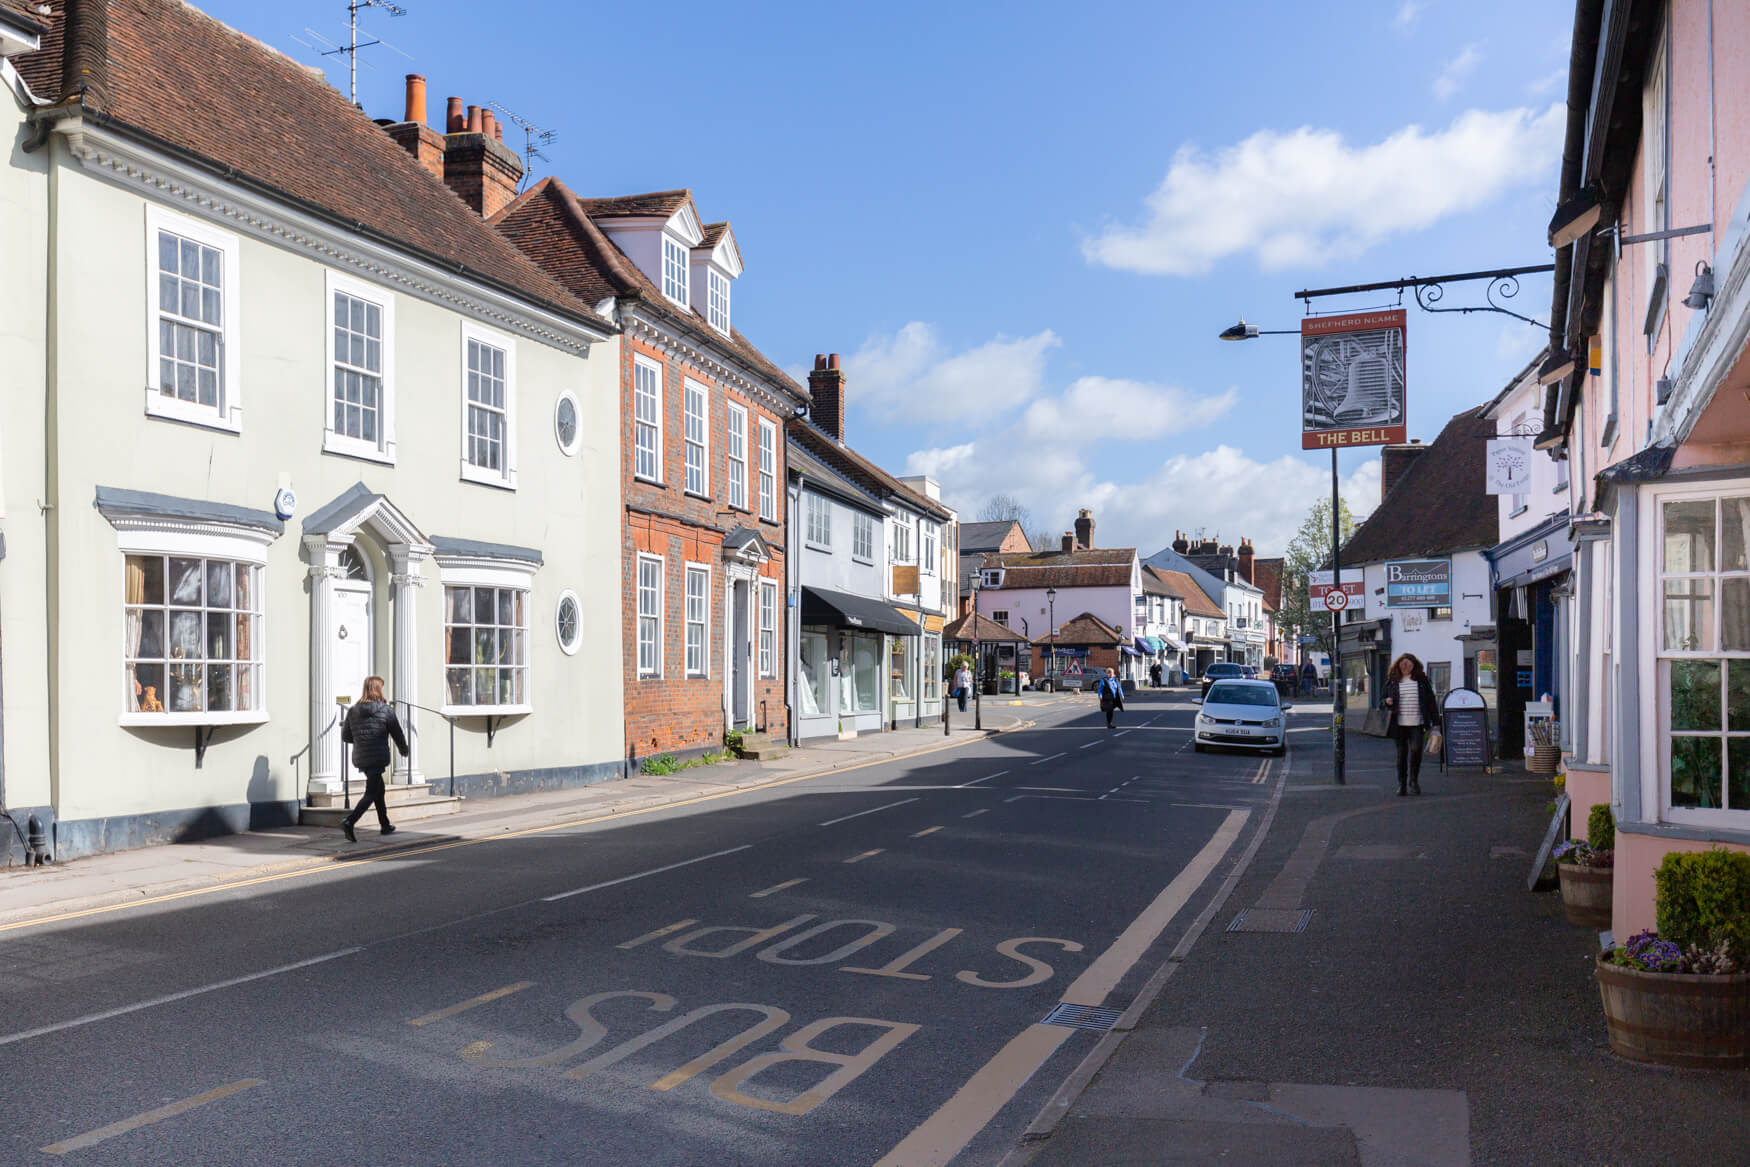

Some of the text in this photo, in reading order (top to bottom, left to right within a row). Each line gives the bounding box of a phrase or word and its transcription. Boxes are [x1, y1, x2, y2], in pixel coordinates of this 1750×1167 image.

[1316, 429, 1390, 446] THE BELL
[1389, 565, 1448, 583] Barringtons
[1401, 584, 1437, 594] TO LET
[1328, 595, 1345, 605] 20
[660, 914, 1085, 990] STOP
[459, 989, 921, 1116] BUS
